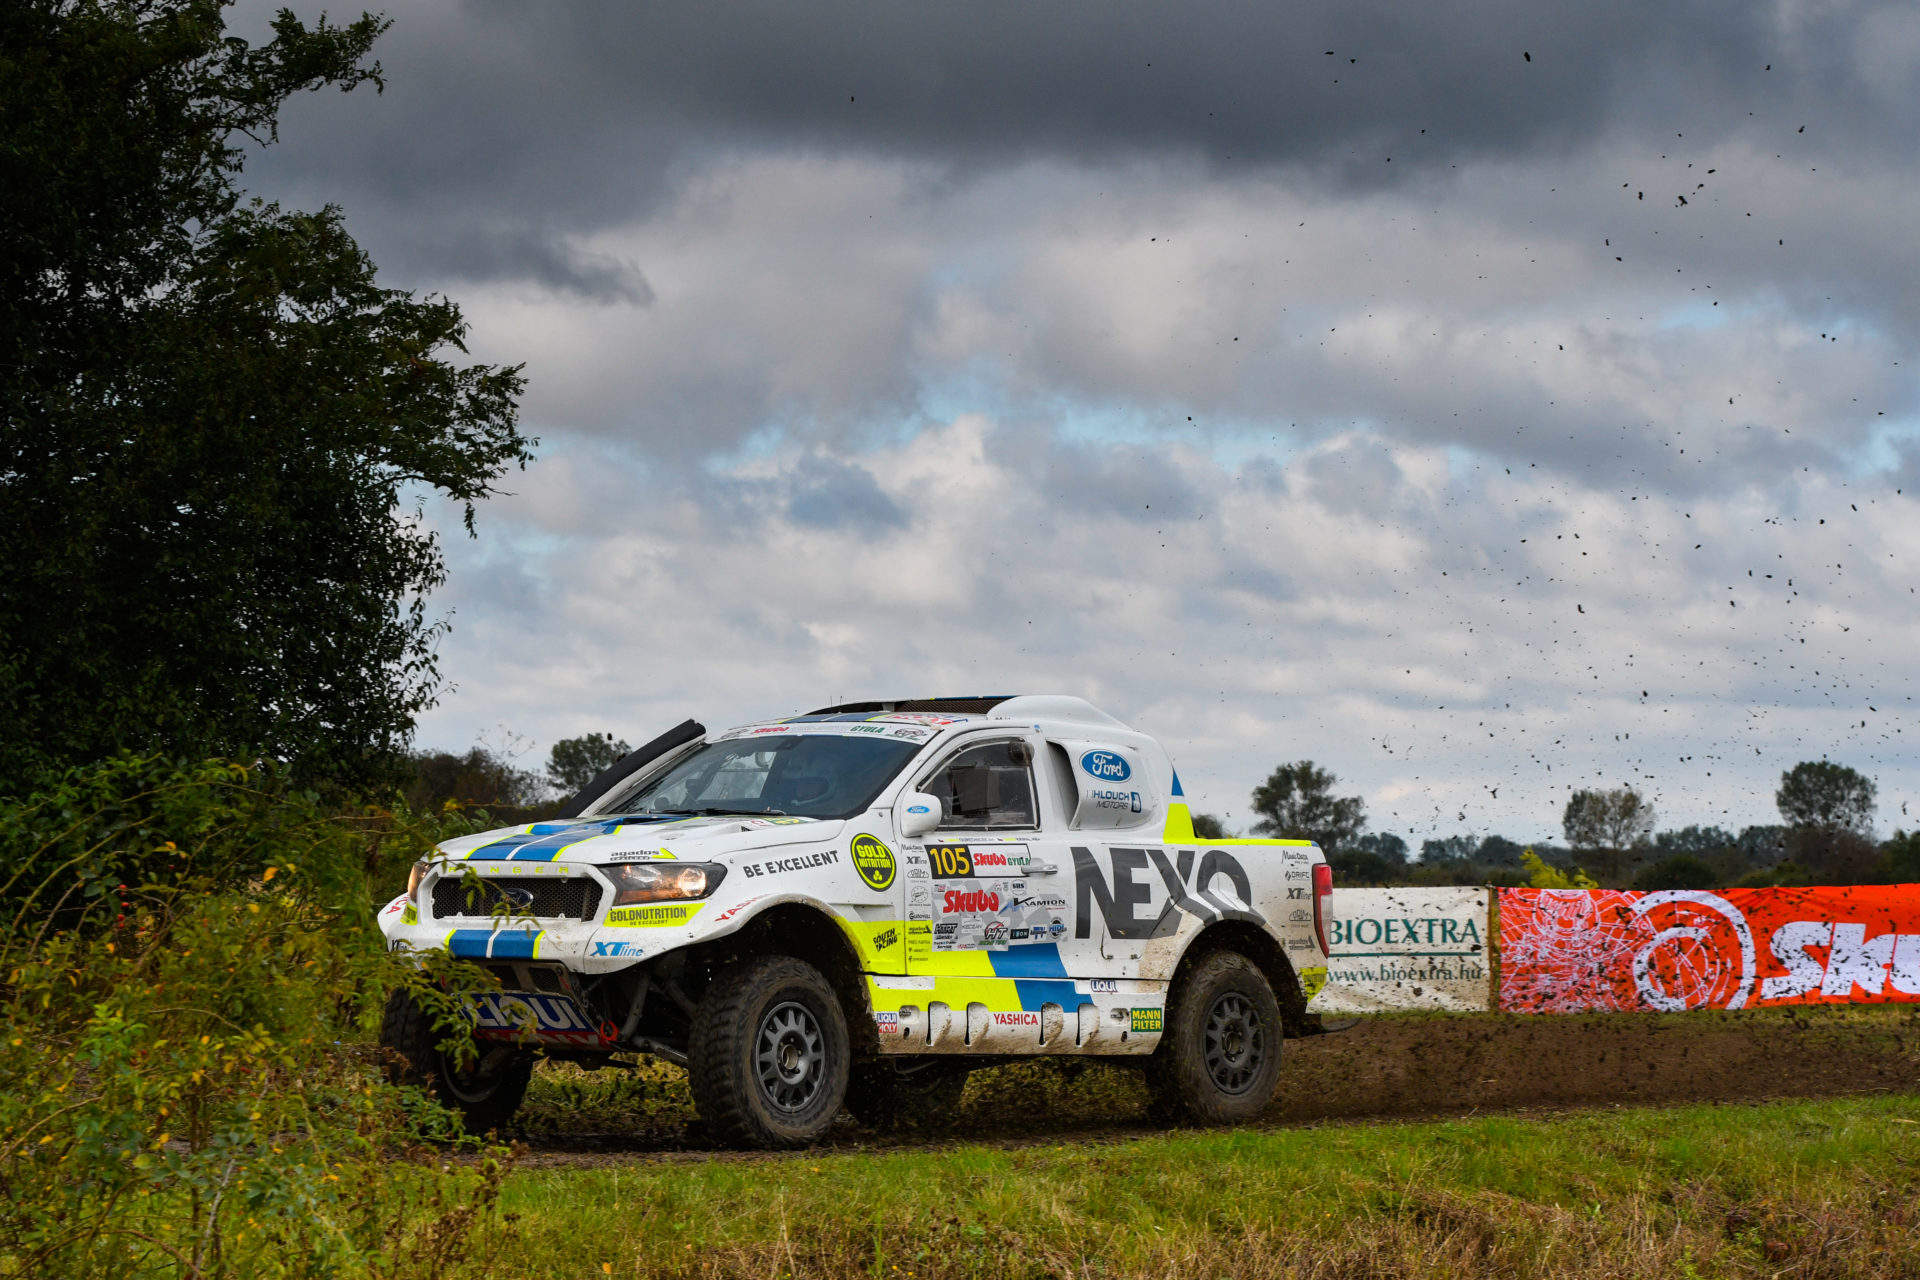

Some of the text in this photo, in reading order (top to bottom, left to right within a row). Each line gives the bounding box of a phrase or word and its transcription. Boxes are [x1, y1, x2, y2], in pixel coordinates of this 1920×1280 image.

[850, 725, 886, 734] GYULA
[1092, 753, 1124, 777] Ford
[1096, 800, 1129, 810] MOTORS
[856, 844, 886, 858] GOLD
[743, 850, 840, 878] BE EXCELLENT
[858, 857, 892, 869] NUTRITION
[929, 847, 970, 875] 105
[1007, 857, 1031, 866] GYULA
[1070, 846, 1264, 940] NEXO
[1013, 896, 1066, 907] KAMION
[610, 907, 687, 922] GOLDNUTRITION
[1329, 918, 1481, 945] BIOEXTRA
[590, 941, 644, 957] XTline
[1327, 963, 1483, 982] www.bioextra.hu
[877, 1013, 897, 1023] LIQUI
[993, 1013, 1039, 1026] YASHICA
[1132, 1009, 1161, 1020] MANN
[1132, 1020, 1161, 1030] FILTER
